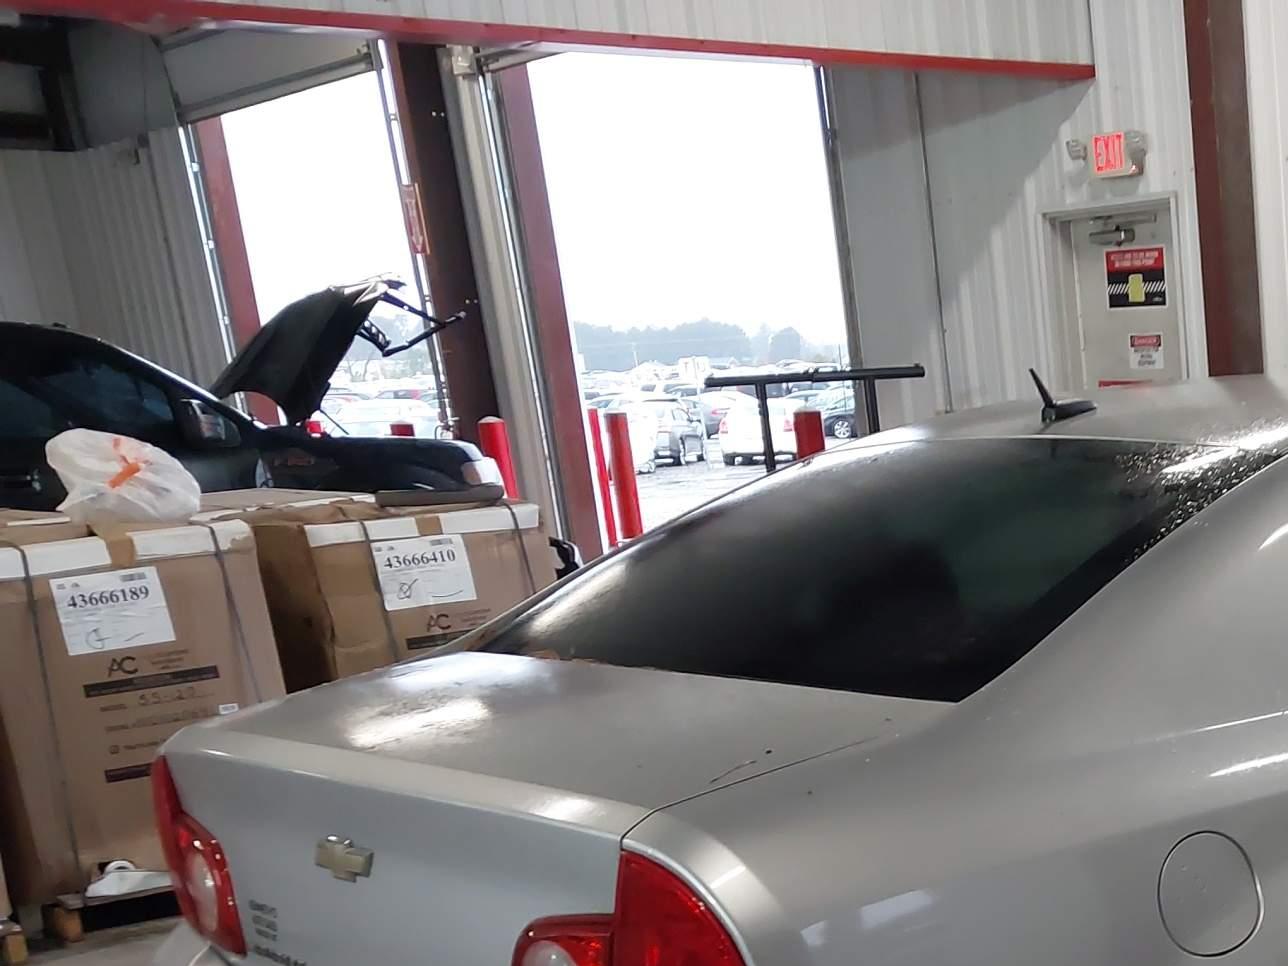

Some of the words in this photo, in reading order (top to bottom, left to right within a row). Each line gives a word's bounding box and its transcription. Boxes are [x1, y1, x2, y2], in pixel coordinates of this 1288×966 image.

[1095, 134, 1123, 171] EXIT
[384, 549, 456, 569] 43666410
[67, 585, 149, 608] 43666189
[427, 613, 452, 633] AC
[108, 656, 138, 677] AC
